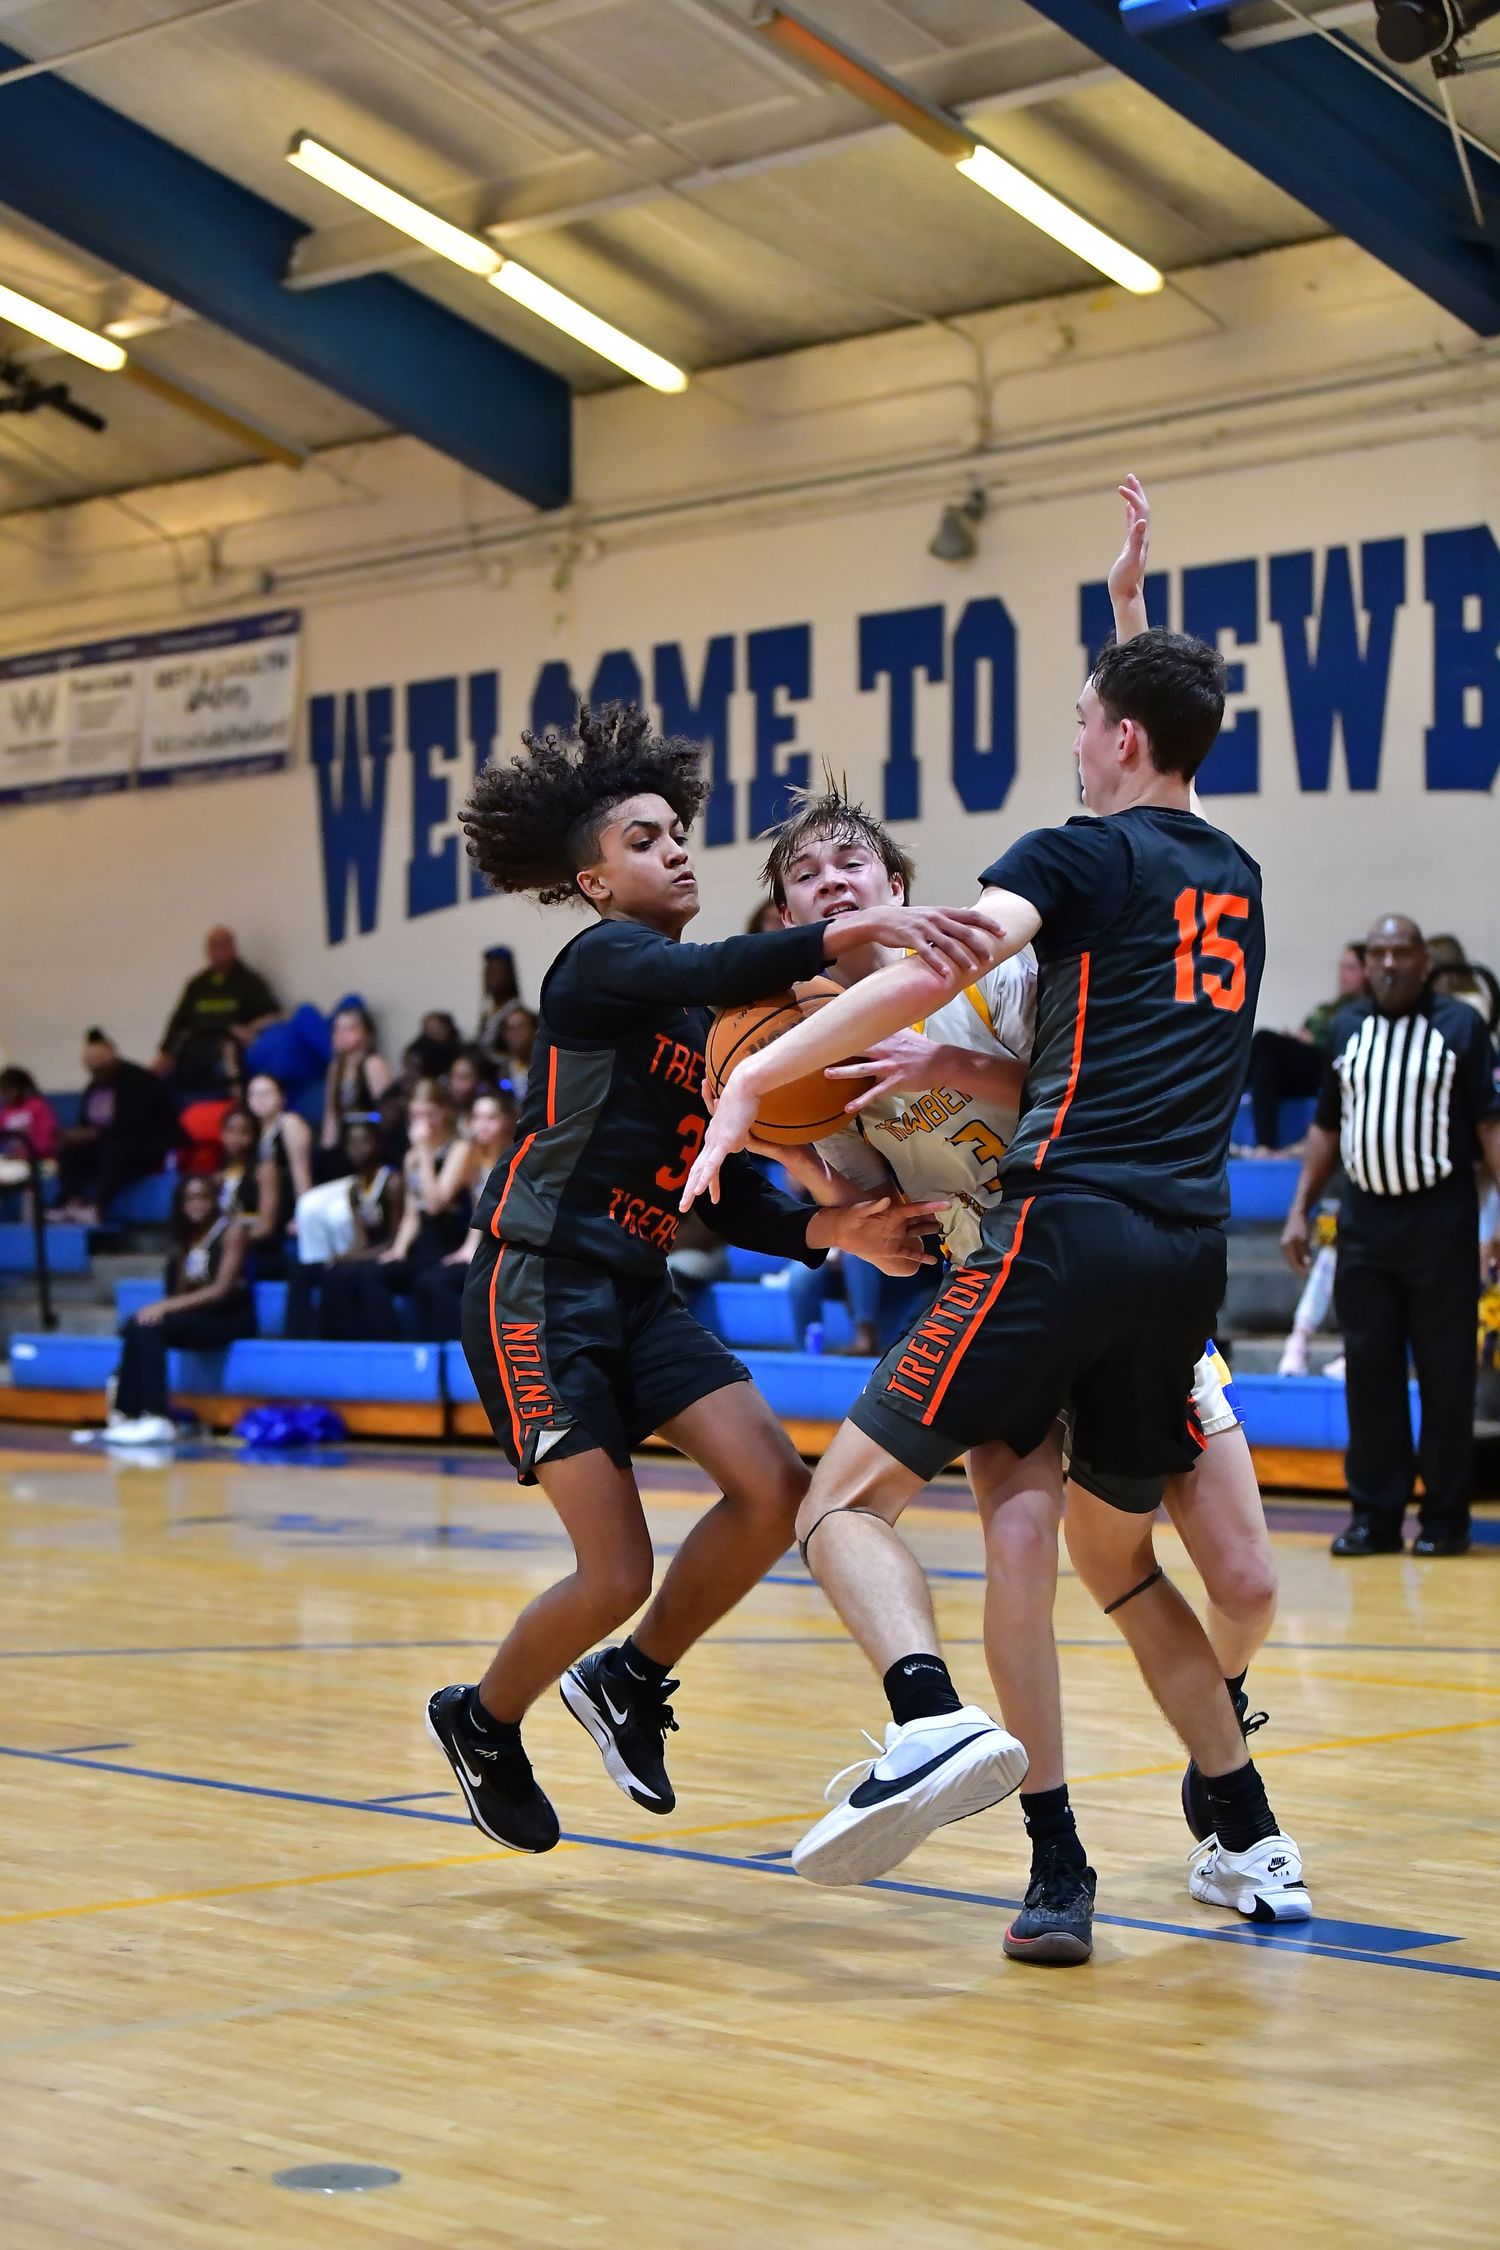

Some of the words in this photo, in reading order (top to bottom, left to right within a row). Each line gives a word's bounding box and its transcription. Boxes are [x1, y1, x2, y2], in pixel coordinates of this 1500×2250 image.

[858, 596, 1018, 821] TO
[1174, 887, 1249, 1013] 15
[655, 1114, 705, 1192] 3
[886, 1266, 992, 1402] TRENTON
[1270, 1856, 1286, 1866] NIKE
[1272, 1870, 1290, 1878] AIR
